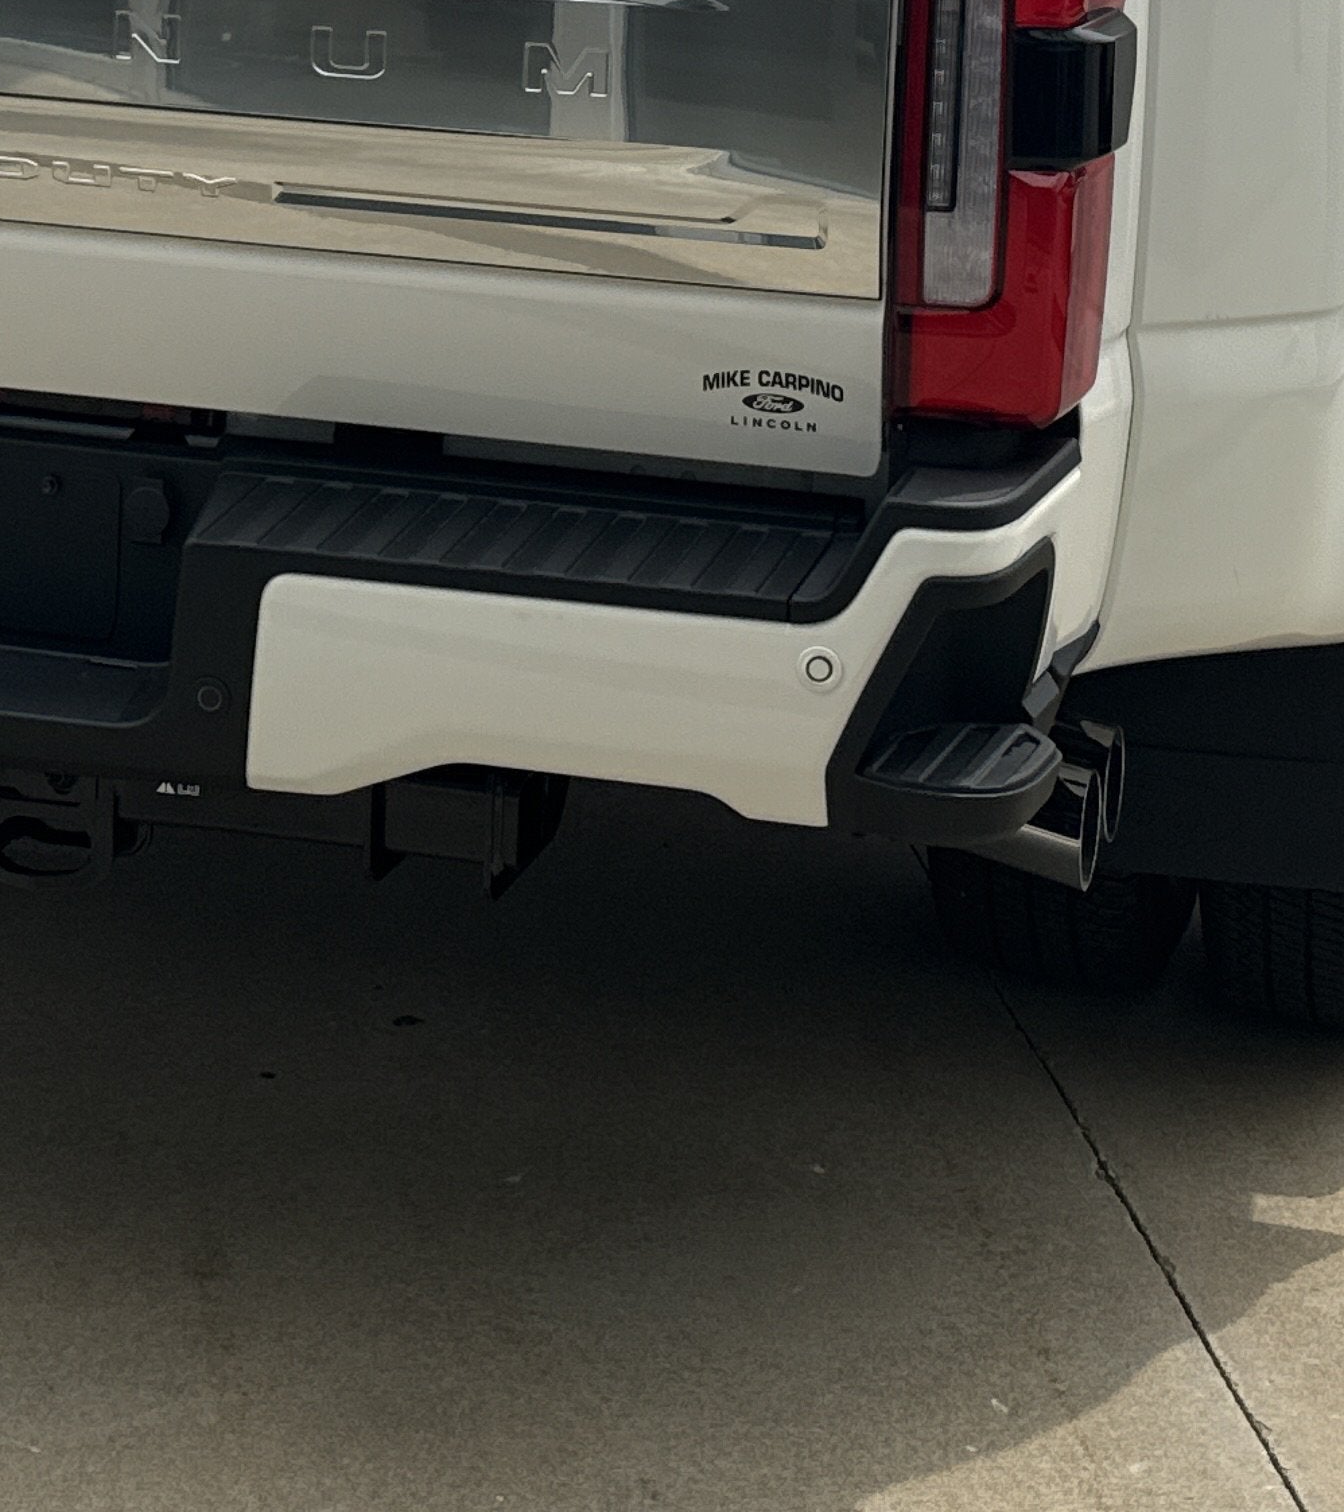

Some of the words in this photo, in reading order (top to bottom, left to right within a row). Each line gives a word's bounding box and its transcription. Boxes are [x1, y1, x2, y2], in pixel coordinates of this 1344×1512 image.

[702, 369, 751, 391] MIKE
[757, 369, 844, 403] CARPINO
[730, 415, 817, 433] LINCOLN
